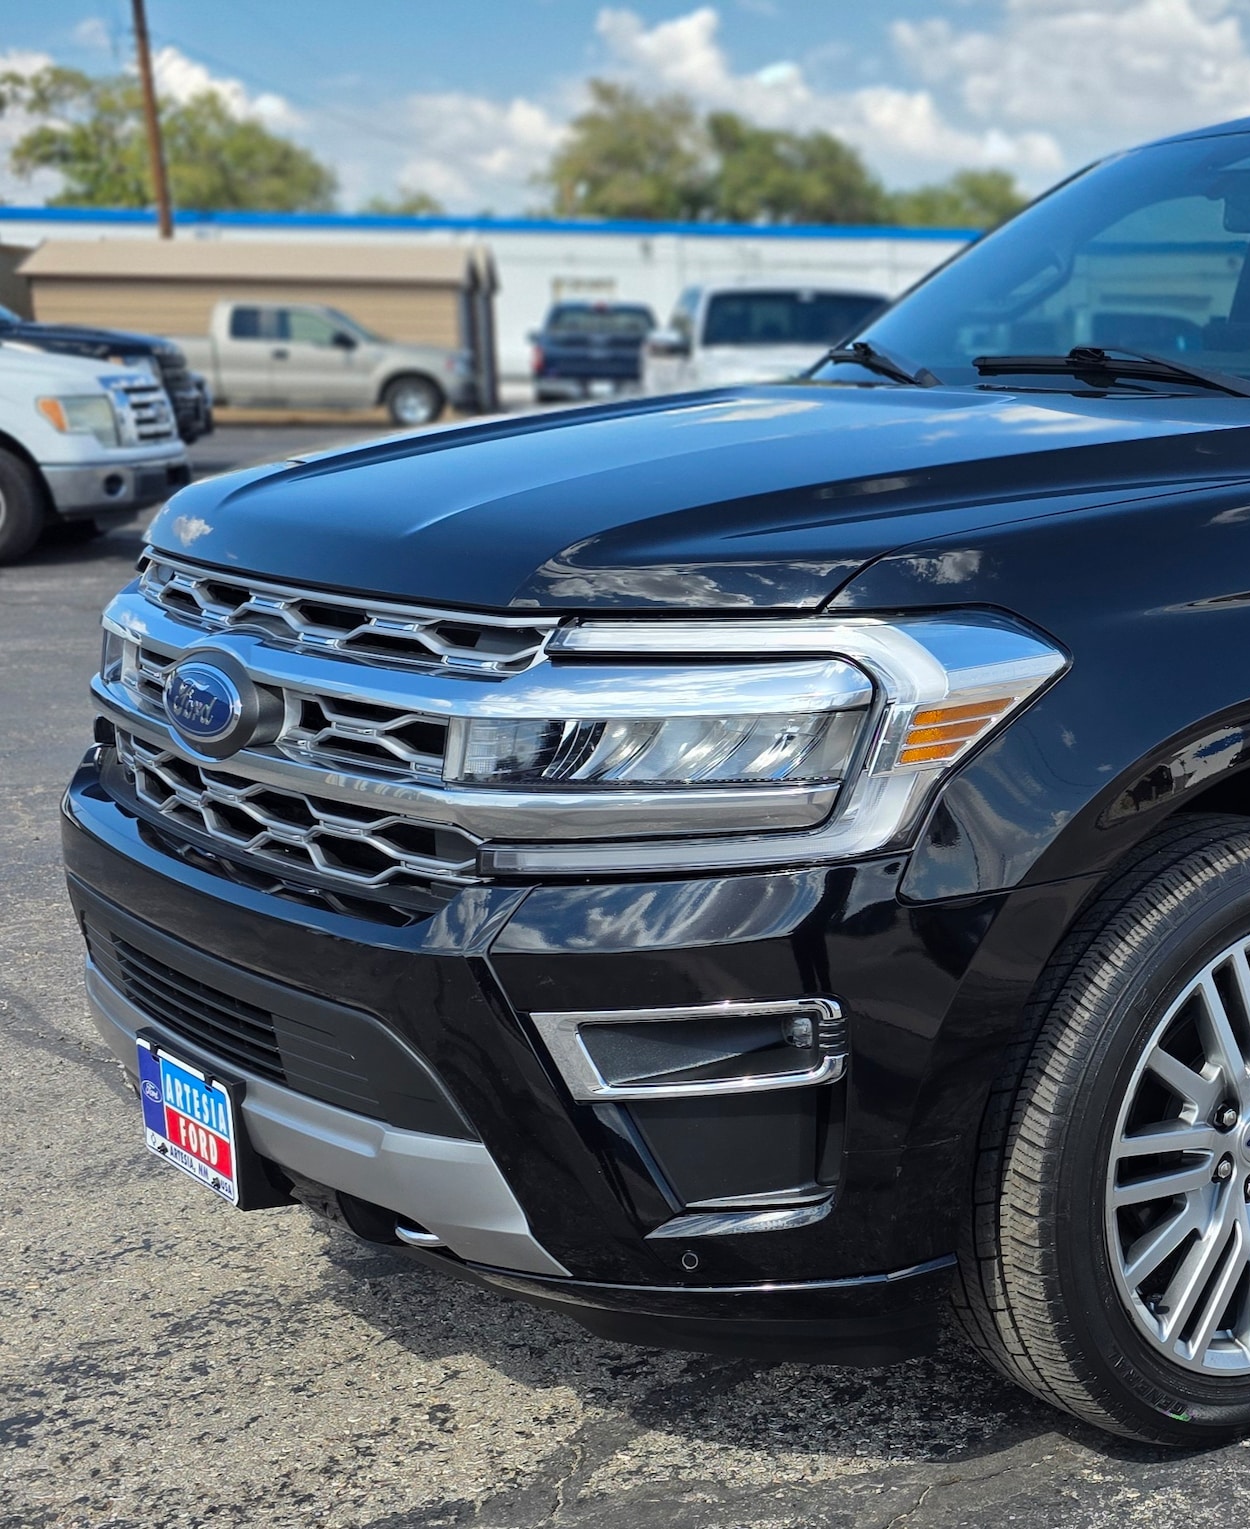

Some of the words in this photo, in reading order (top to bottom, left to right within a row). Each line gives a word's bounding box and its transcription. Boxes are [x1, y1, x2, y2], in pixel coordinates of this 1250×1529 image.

[173, 677, 217, 725] Ford
[164, 1073, 229, 1137] ARTESIA
[178, 1116, 218, 1166] FORD
[170, 1145, 196, 1172] ARTESIA,
[198, 1162, 209, 1180] NM
[220, 1179, 233, 1196] USA
